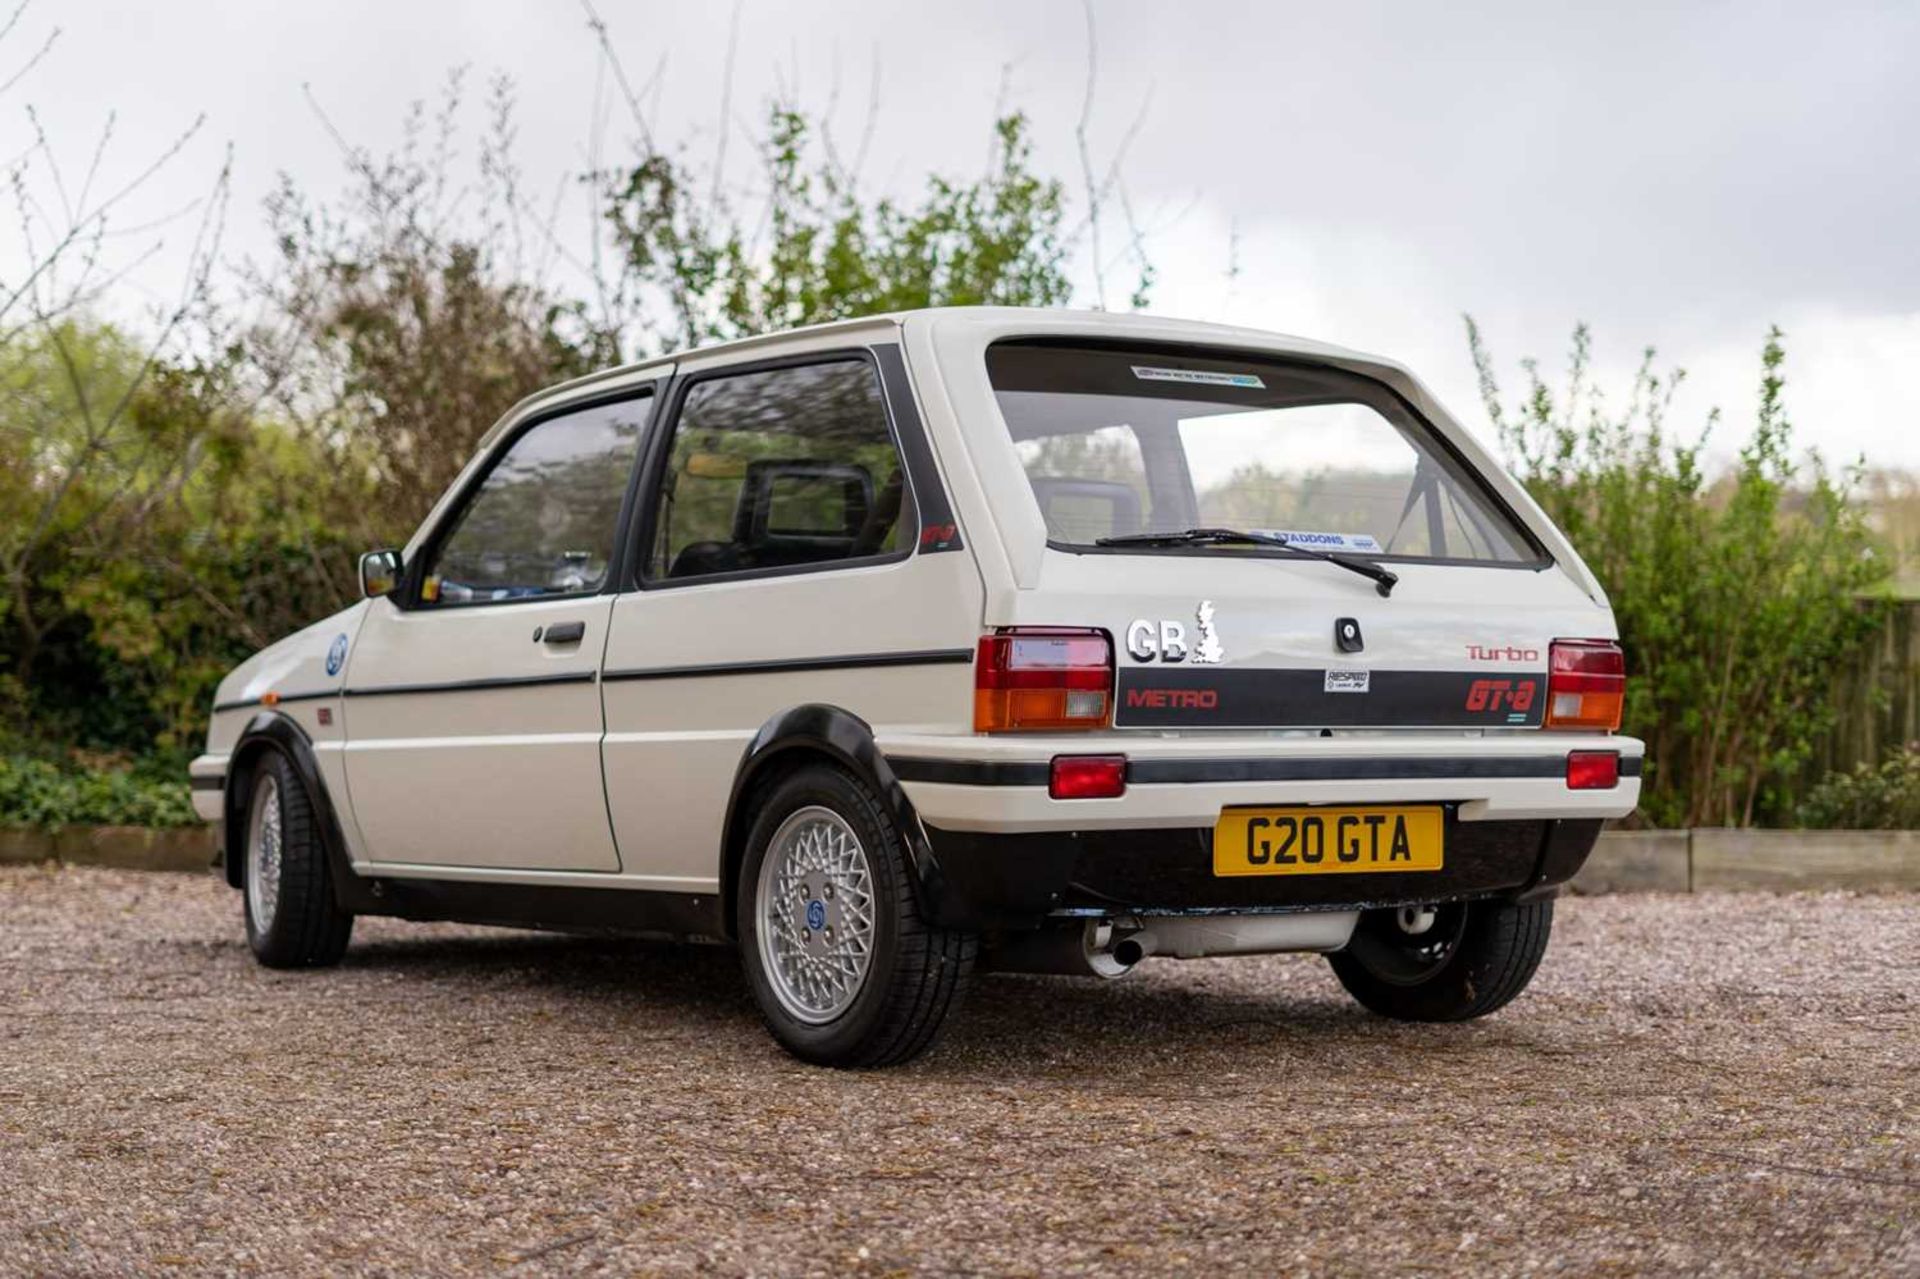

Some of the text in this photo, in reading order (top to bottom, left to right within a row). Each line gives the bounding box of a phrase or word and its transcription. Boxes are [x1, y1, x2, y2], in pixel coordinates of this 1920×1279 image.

[1274, 532, 1345, 546] STADDONS
[1127, 619, 1187, 663] GB
[1465, 645, 1539, 662] Turbo
[1127, 689, 1219, 708] METRO
[1247, 815, 1412, 865] G20 GTA
